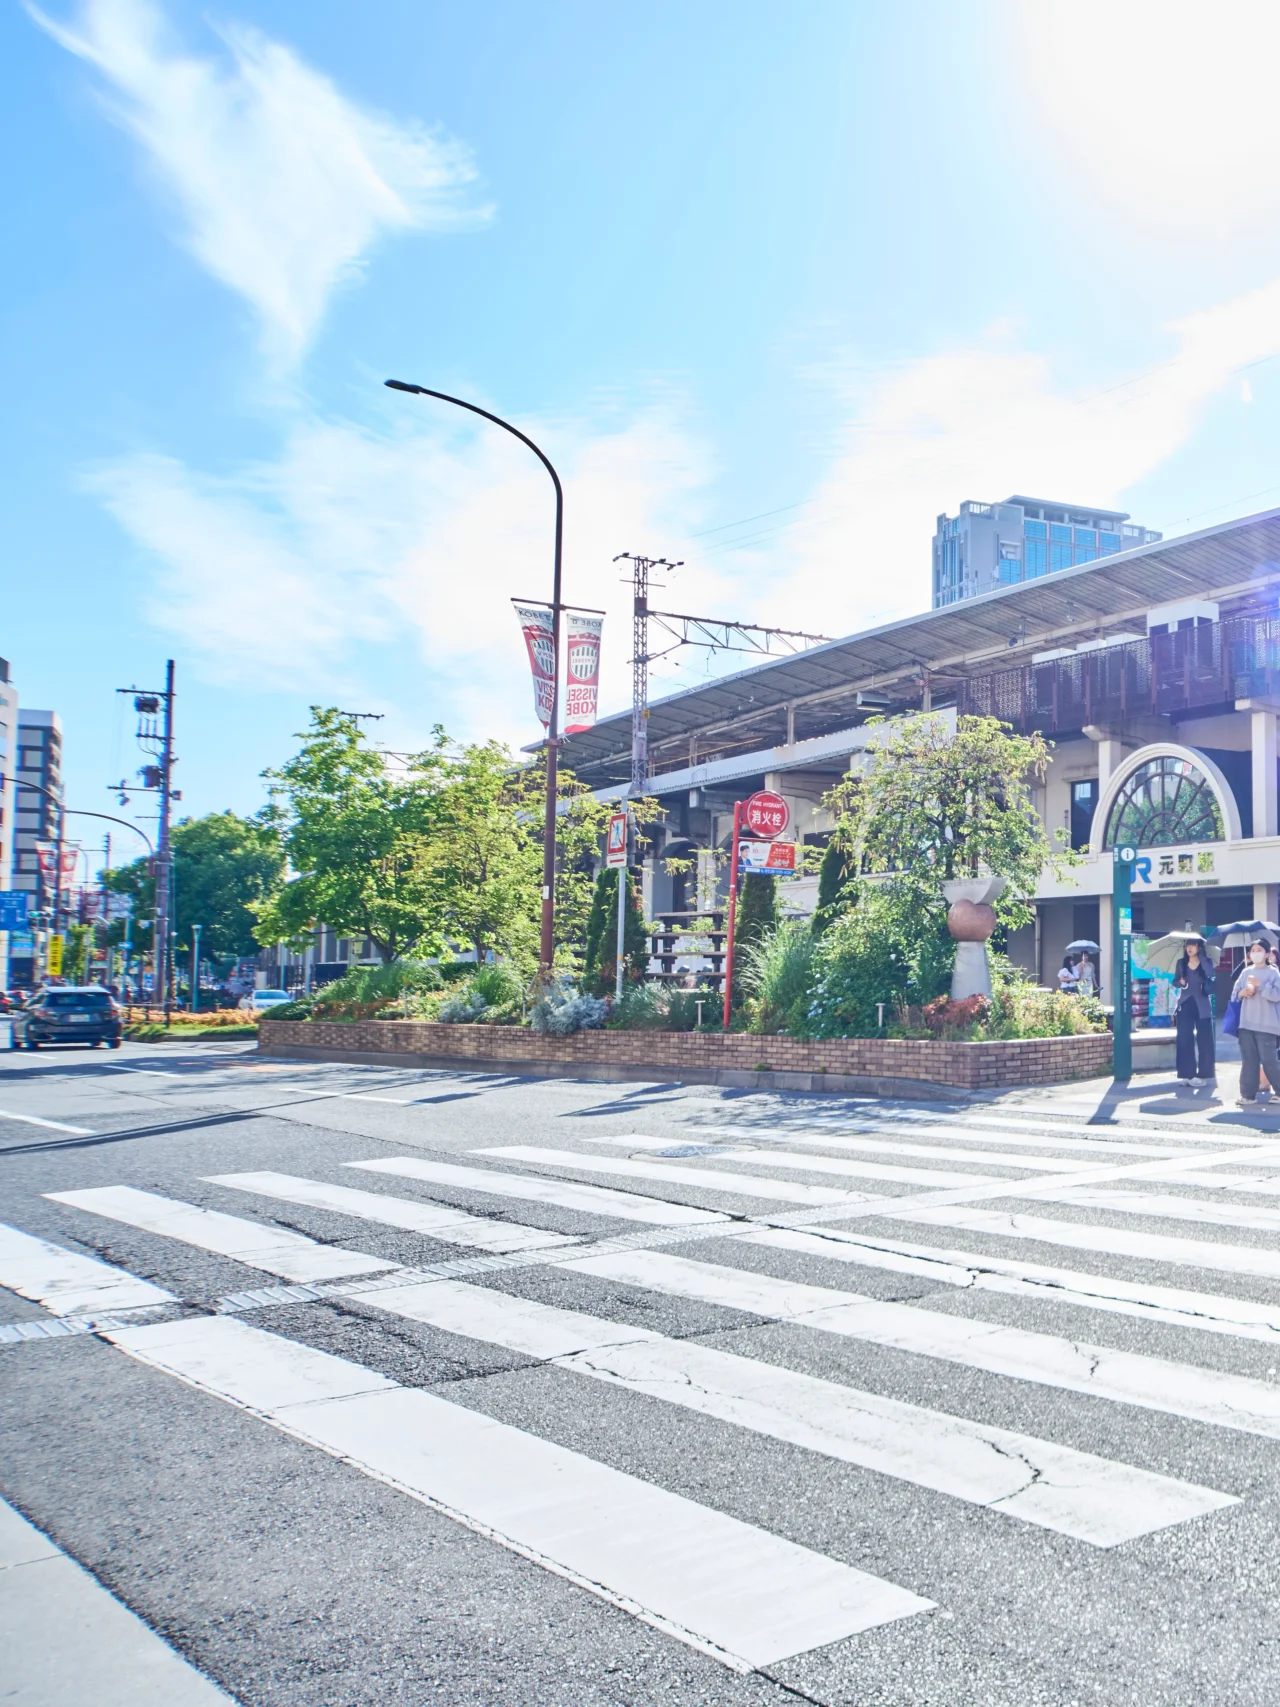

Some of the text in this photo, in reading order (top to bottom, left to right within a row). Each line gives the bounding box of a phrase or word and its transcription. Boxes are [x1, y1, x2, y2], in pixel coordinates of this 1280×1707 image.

[751, 810, 782, 826] 消火栓
[1158, 852, 1215, 875] 元町駅
